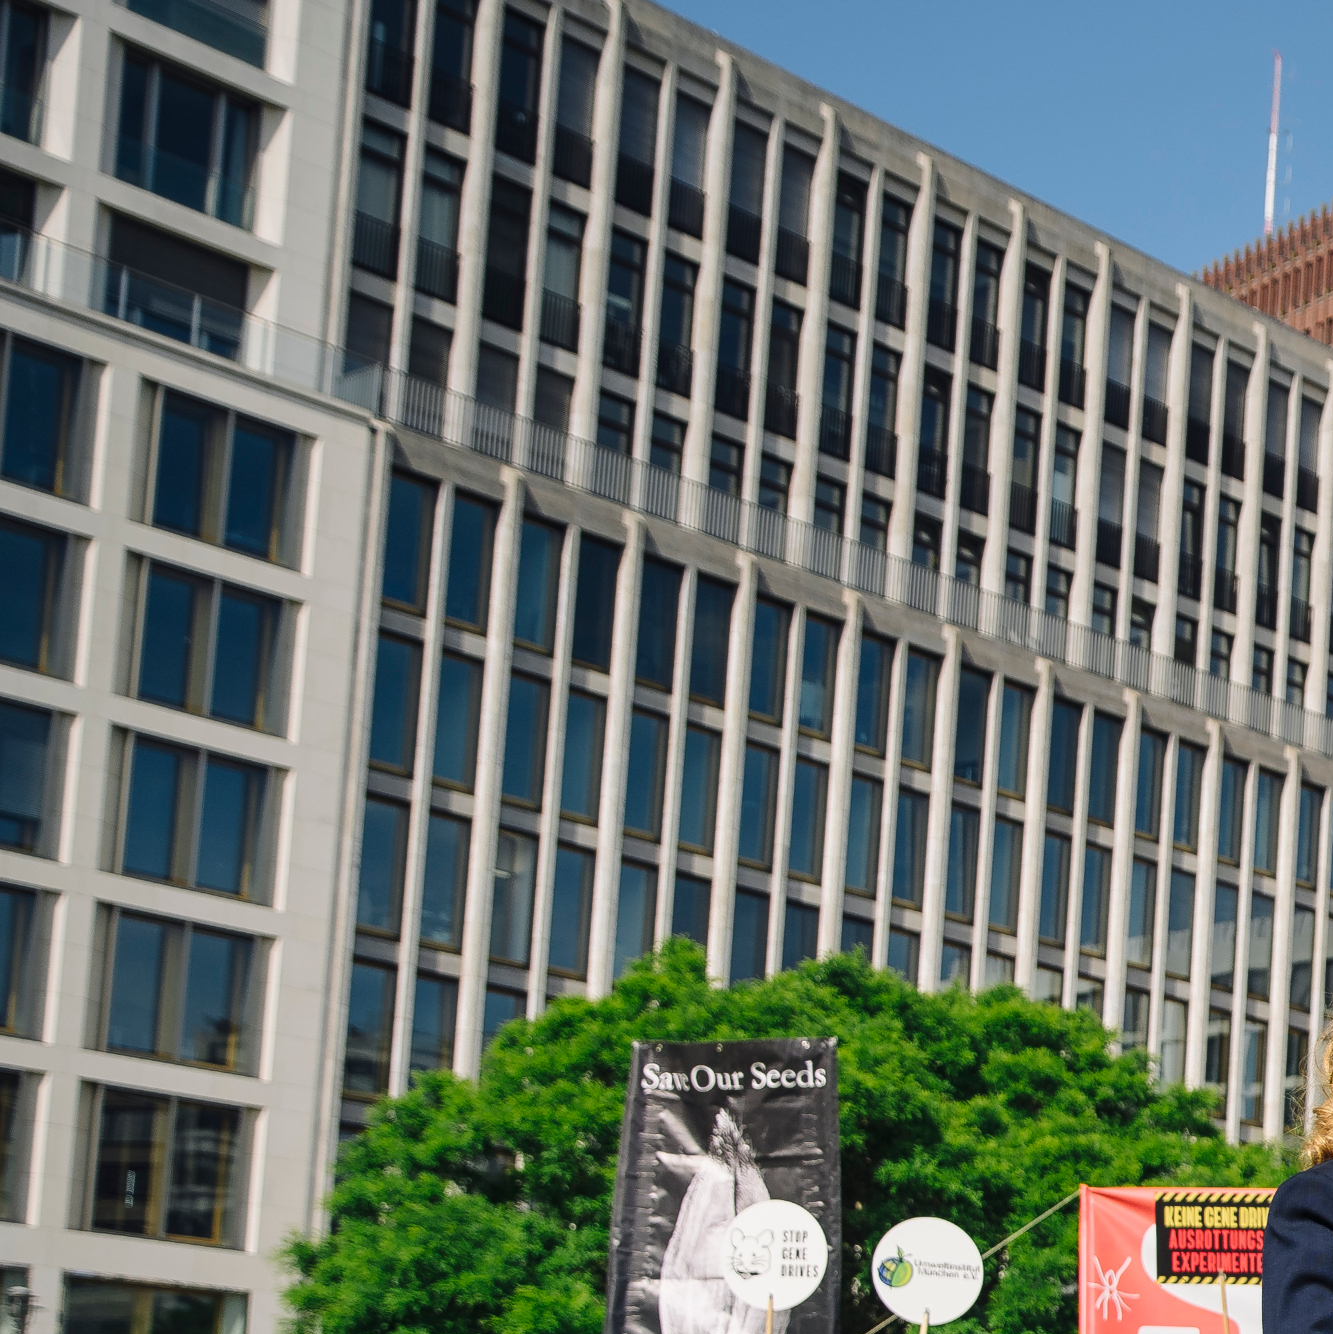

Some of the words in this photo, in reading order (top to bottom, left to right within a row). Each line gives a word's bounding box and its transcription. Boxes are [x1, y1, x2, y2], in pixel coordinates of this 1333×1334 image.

[690, 1064, 744, 1092] Our
[750, 1059, 827, 1090] Seeds
[1163, 1205, 1203, 1228] KEINE
[1203, 1206, 1238, 1229] GENE
[1238, 1206, 1269, 1230] DRIV
[783, 1230, 809, 1244] STOP
[1168, 1228, 1264, 1251] AUSROTTUNGS
[782, 1246, 808, 1261] GENE
[1171, 1251, 1263, 1274] EXPERIMENTE
[781, 1264, 819, 1279] DRIVES
